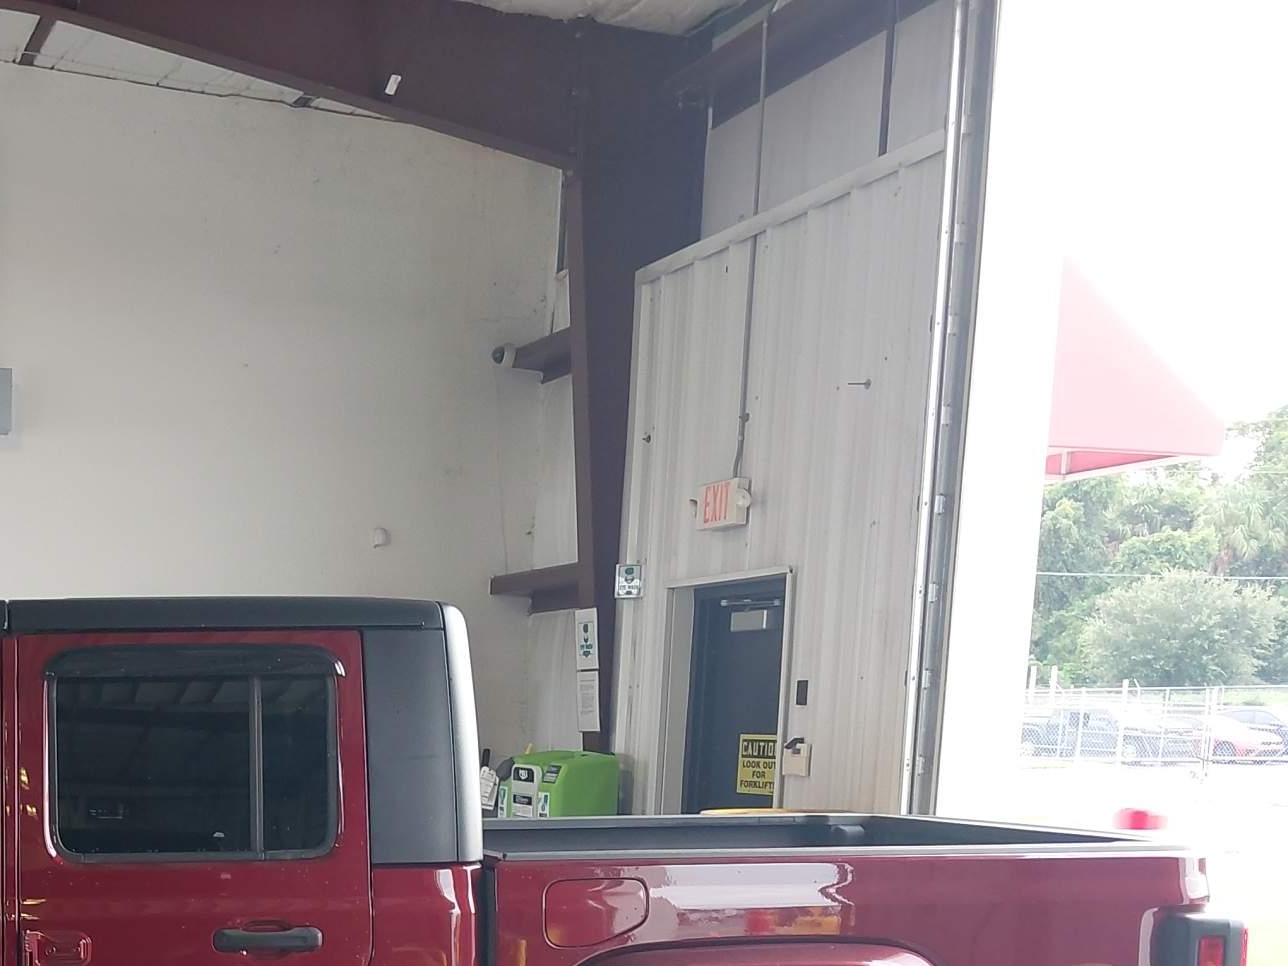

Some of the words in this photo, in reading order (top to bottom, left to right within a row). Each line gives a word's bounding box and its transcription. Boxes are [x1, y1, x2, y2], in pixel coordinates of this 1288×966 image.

[703, 481, 730, 524] EXIT
[742, 760, 761, 769] LOOK
[751, 770, 766, 779] FOR
